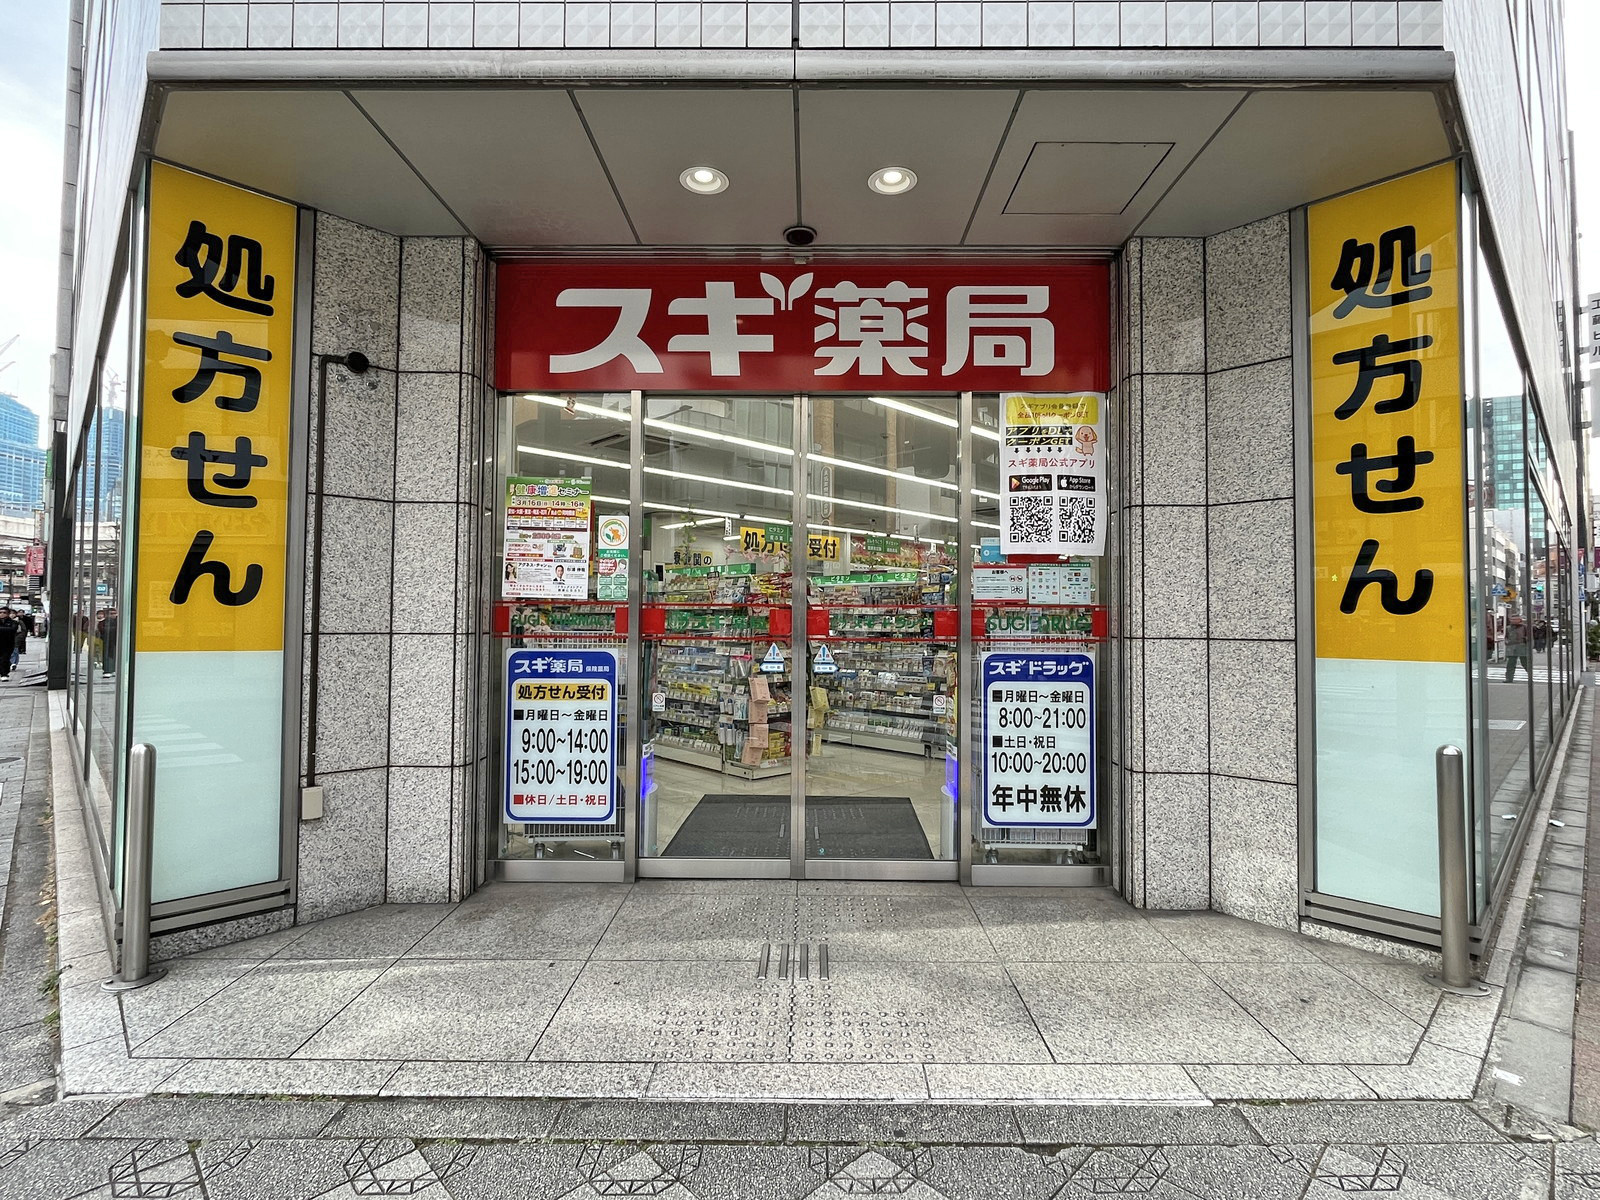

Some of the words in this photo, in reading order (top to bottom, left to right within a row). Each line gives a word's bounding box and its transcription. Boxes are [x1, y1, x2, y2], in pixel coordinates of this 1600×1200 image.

[549, 272, 1055, 376] スギ薬局
[169, 219, 275, 607] 処方せん
[1330, 225, 1434, 615] 処方せん
[1007, 437, 1072, 446] クーポンGET
[1008, 457, 1095, 469] スギ薬局公式アプリ
[1021, 476, 1039, 484] Google
[1040, 476, 1051, 484] Play
[511, 614, 541, 627] SUGI
[548, 613, 612, 627] PHARMACY
[986, 615, 1030, 632] SUGI
[1038, 615, 1092, 632] DRUG
[514, 656, 583, 674] スギ薬局
[518, 684, 606, 700] 処方せん受付
[991, 784, 1087, 813] 年中無休
